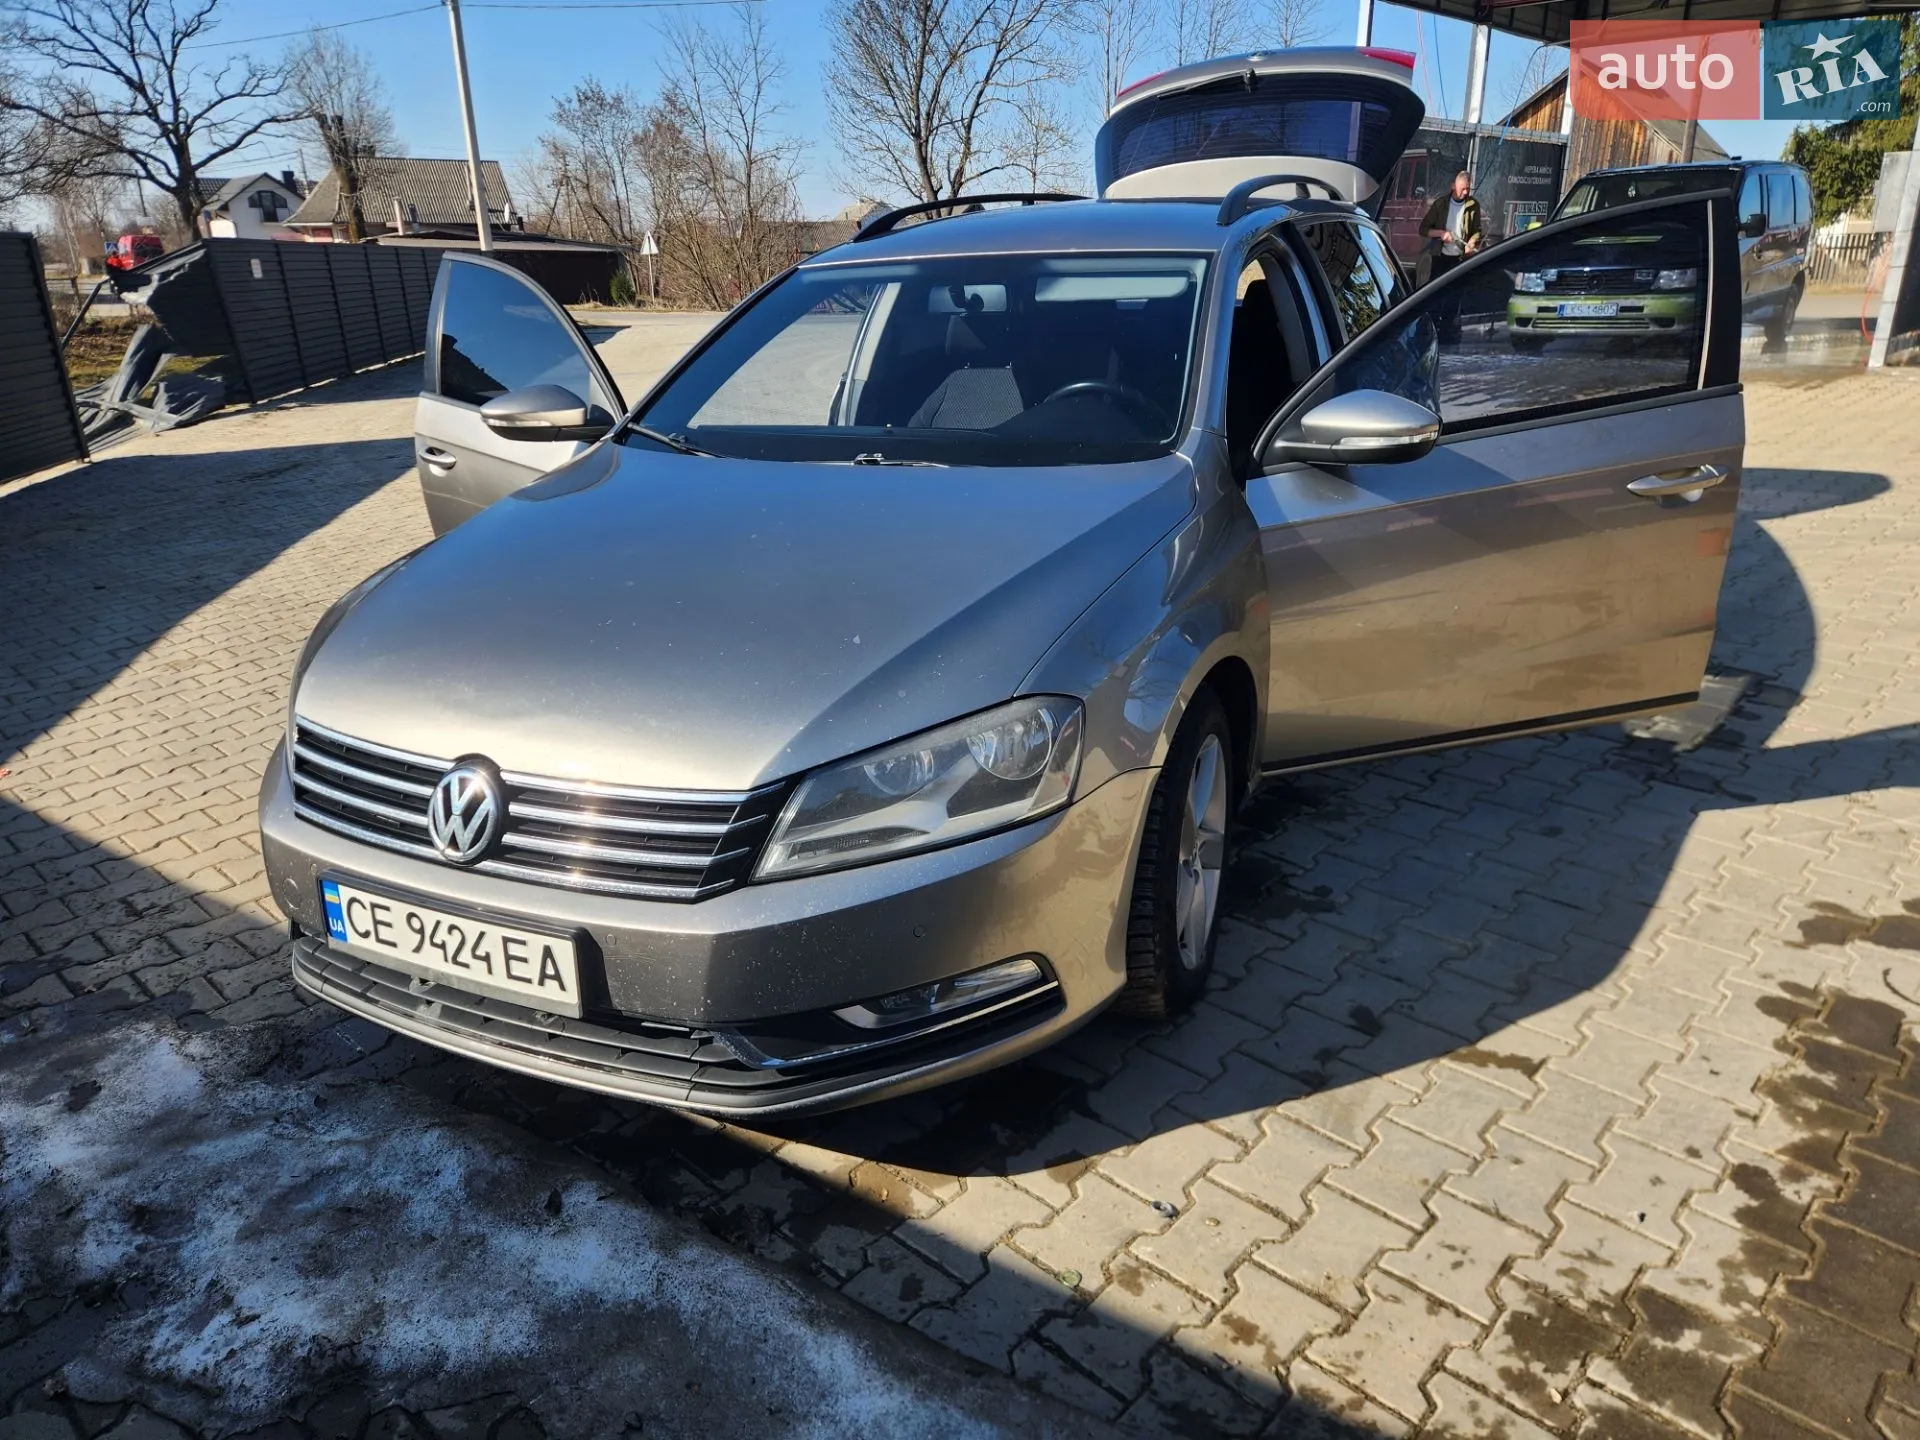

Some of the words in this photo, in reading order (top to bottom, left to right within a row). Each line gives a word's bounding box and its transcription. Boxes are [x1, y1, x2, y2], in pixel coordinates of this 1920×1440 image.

[328, 916, 346, 934] UA
[346, 896, 398, 948] CE
[405, 911, 493, 976] 9424
[501, 935, 567, 992] EA
